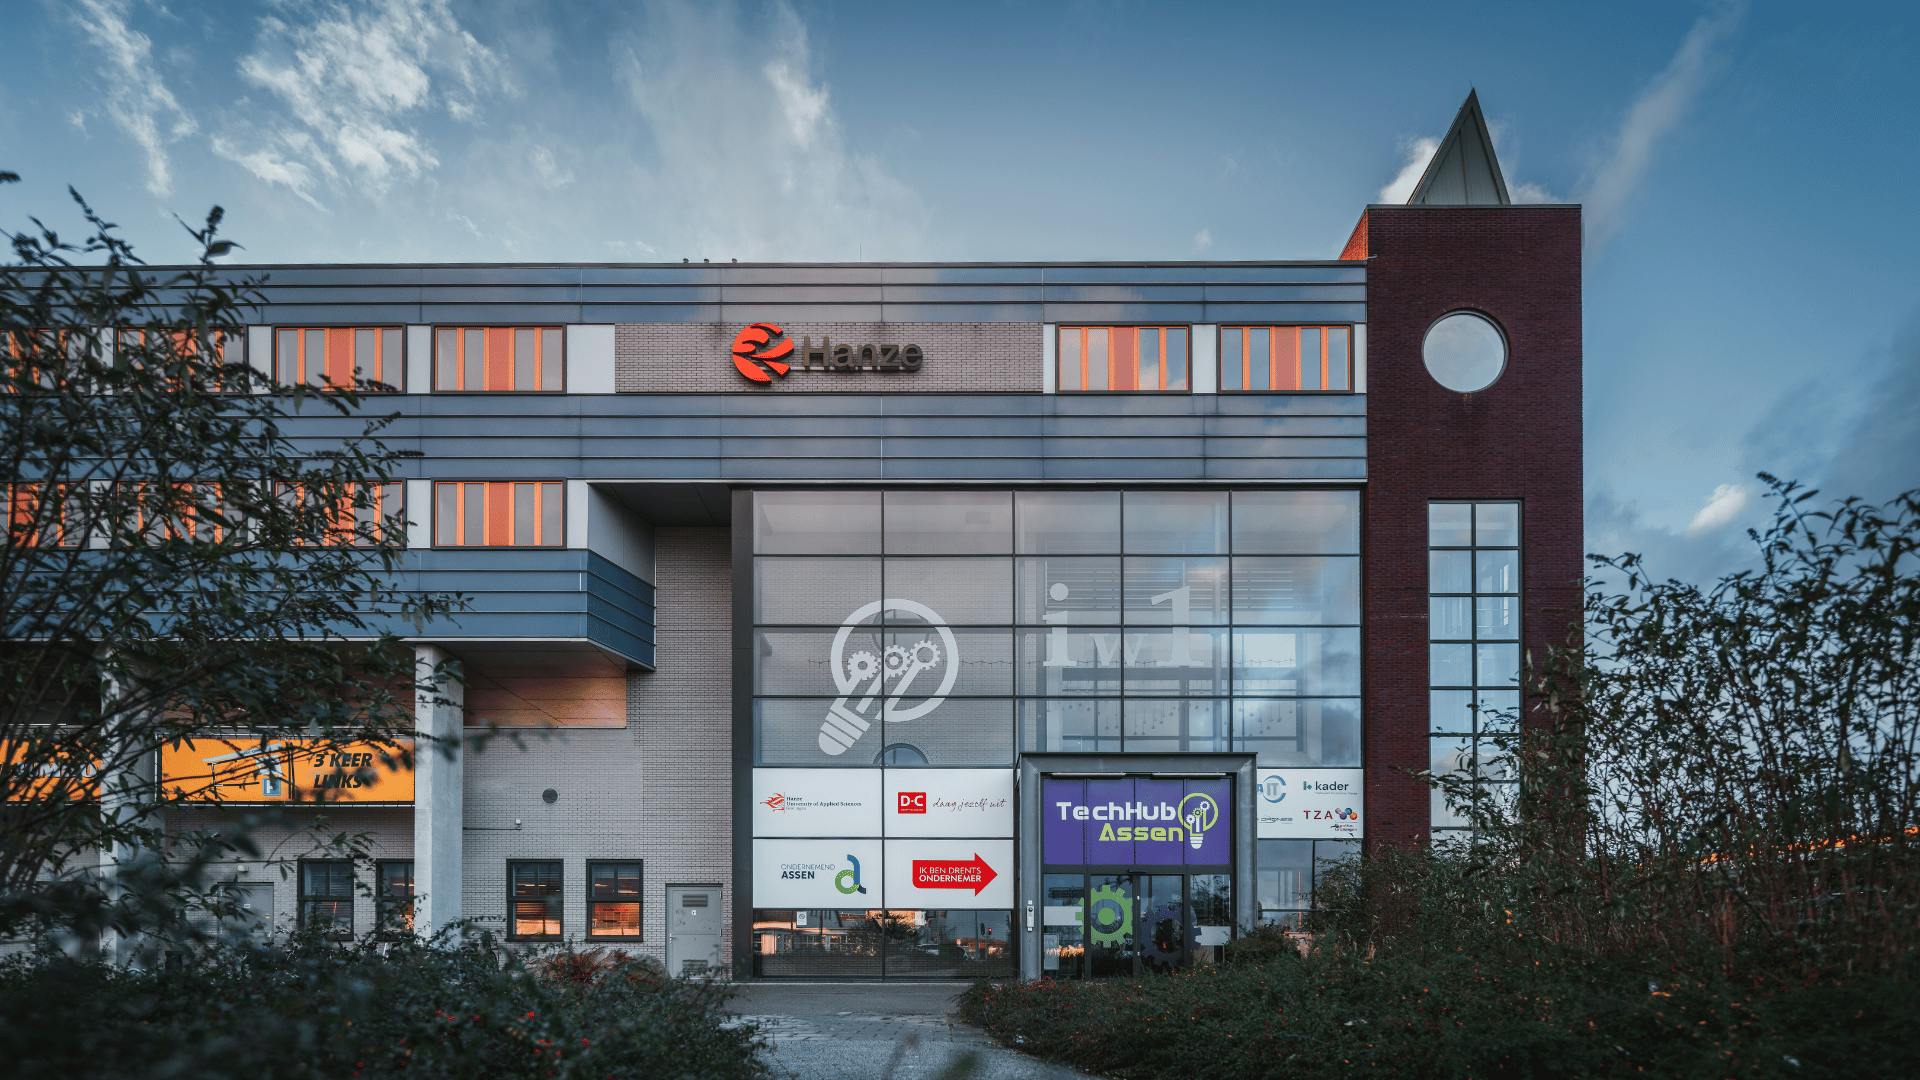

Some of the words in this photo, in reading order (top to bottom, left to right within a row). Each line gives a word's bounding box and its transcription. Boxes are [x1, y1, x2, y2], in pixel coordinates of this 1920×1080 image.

[803, 335, 923, 371] Hanze
[313, 753, 325, 767] 3
[329, 752, 372, 768] KEER
[1315, 781, 1349, 791] kader
[1056, 801, 1176, 821] TechHub
[1098, 823, 1184, 842] Assen
[780, 863, 836, 871] ONDERNEMEND
[919, 866, 927, 875] IK
[929, 866, 946, 875] BEN
[948, 866, 982, 875] DRENTS
[781, 870, 815, 880] ASSEN
[919, 874, 982, 883] ONDERNEMER
